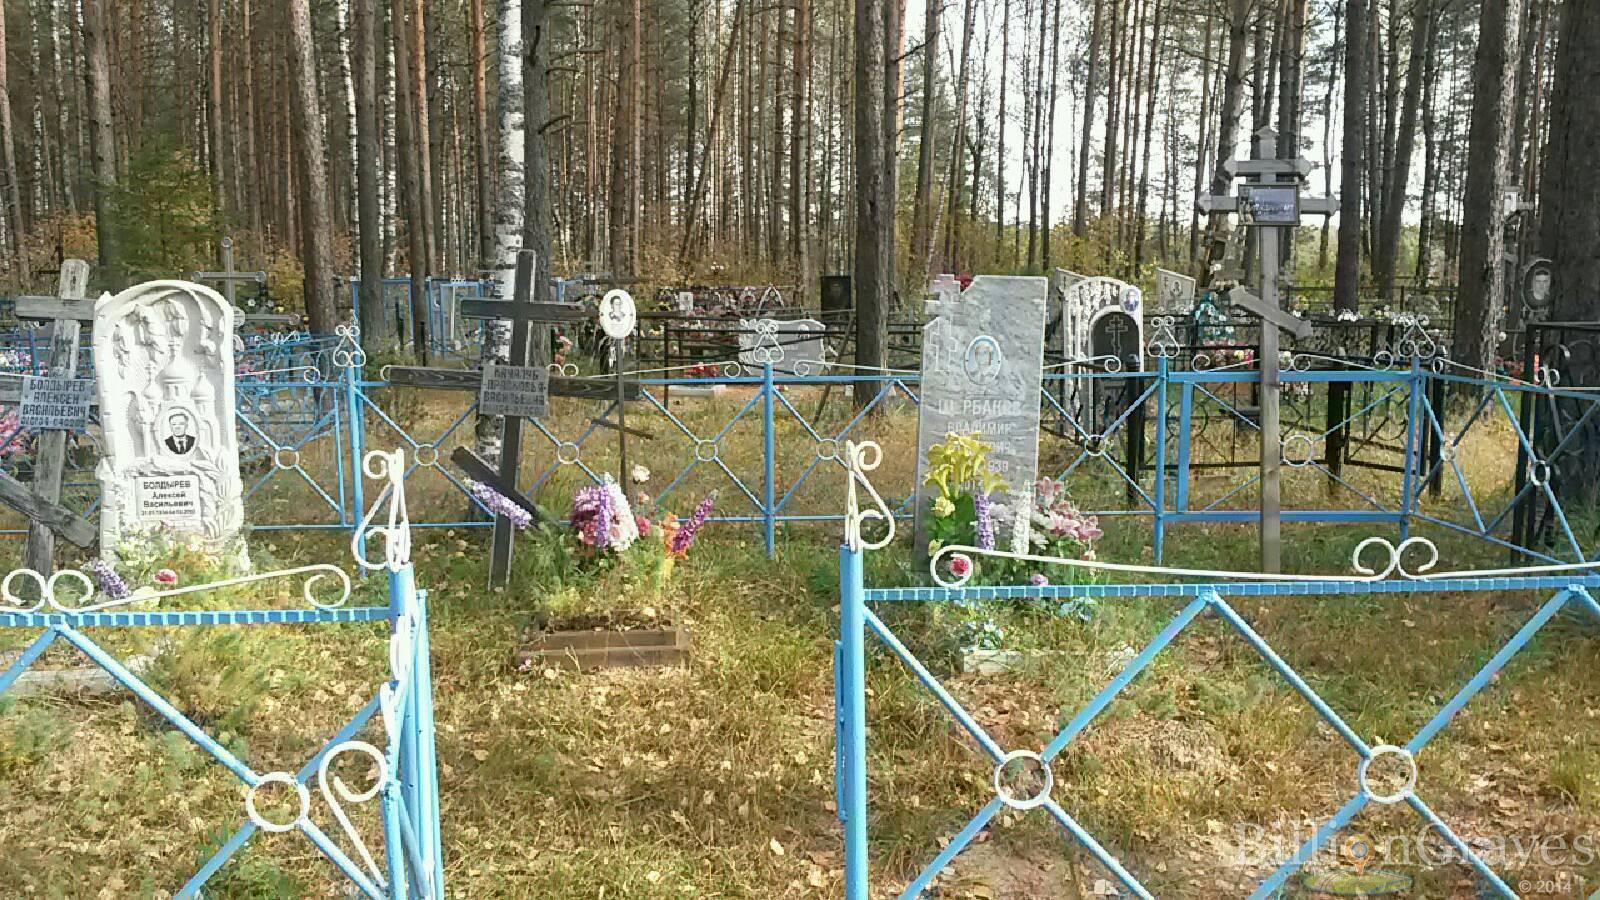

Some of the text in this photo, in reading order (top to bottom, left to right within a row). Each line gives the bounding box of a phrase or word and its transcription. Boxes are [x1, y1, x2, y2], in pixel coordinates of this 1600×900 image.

[30, 379, 86, 392] БОЛДЫРЕВ
[22, 404, 87, 418] ВАСИЛЬЕВИЧ
[938, 399, 1022, 416] ЩРБАКОВ
[143, 480, 191, 491] БОЛДЫРЕВ
